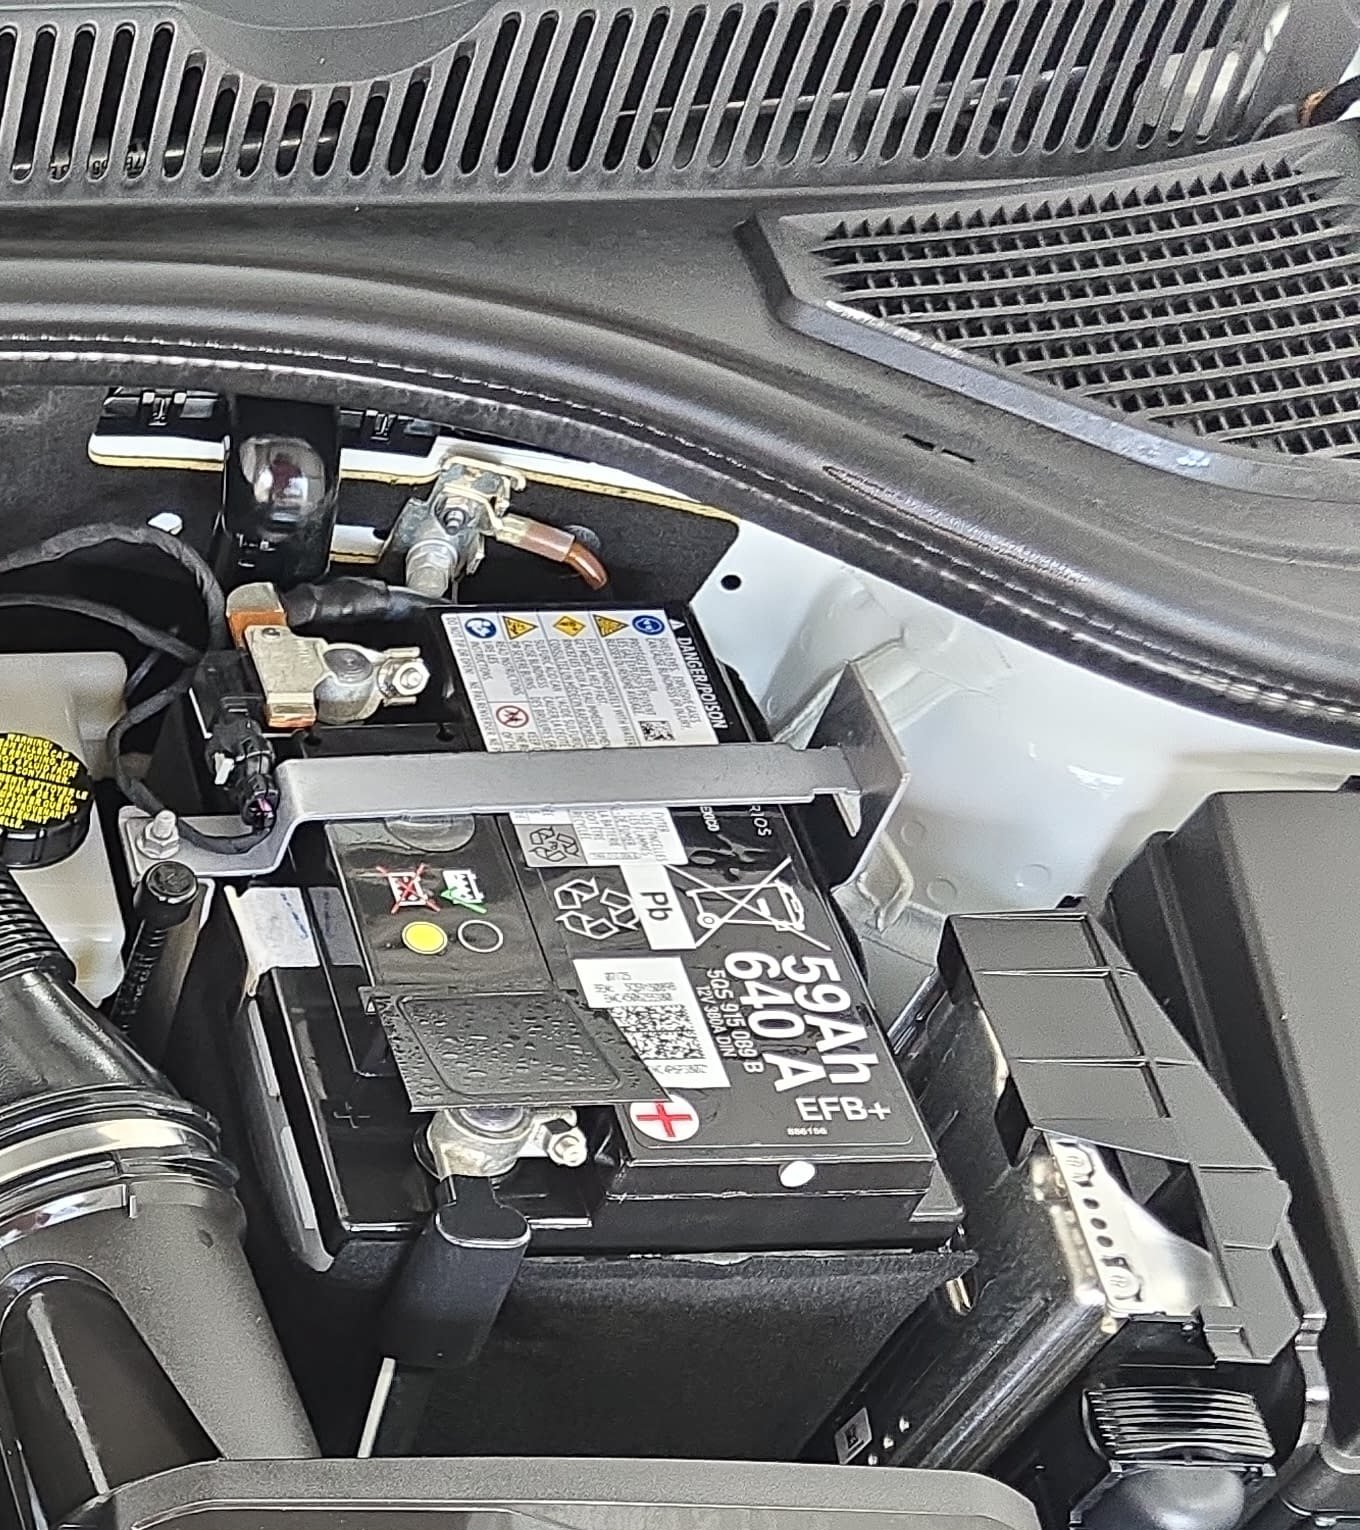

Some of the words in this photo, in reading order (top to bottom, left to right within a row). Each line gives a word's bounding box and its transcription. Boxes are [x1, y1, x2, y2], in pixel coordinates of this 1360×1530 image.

[675, 636, 728, 728] DANGER/POISON
[700, 806, 720, 833] EXICO
[640, 891, 674, 921] Pb
[724, 952, 806, 1040] 640
[696, 985, 714, 1005] 12V
[715, 1035, 738, 1058] DIN
[720, 1003, 746, 1029] 915
[781, 955, 879, 1083] 59Ah
[731, 1030, 758, 1059] 089
[743, 1061, 765, 1074] B
[761, 1053, 827, 1092] A
[795, 1096, 891, 1121] EFB+
